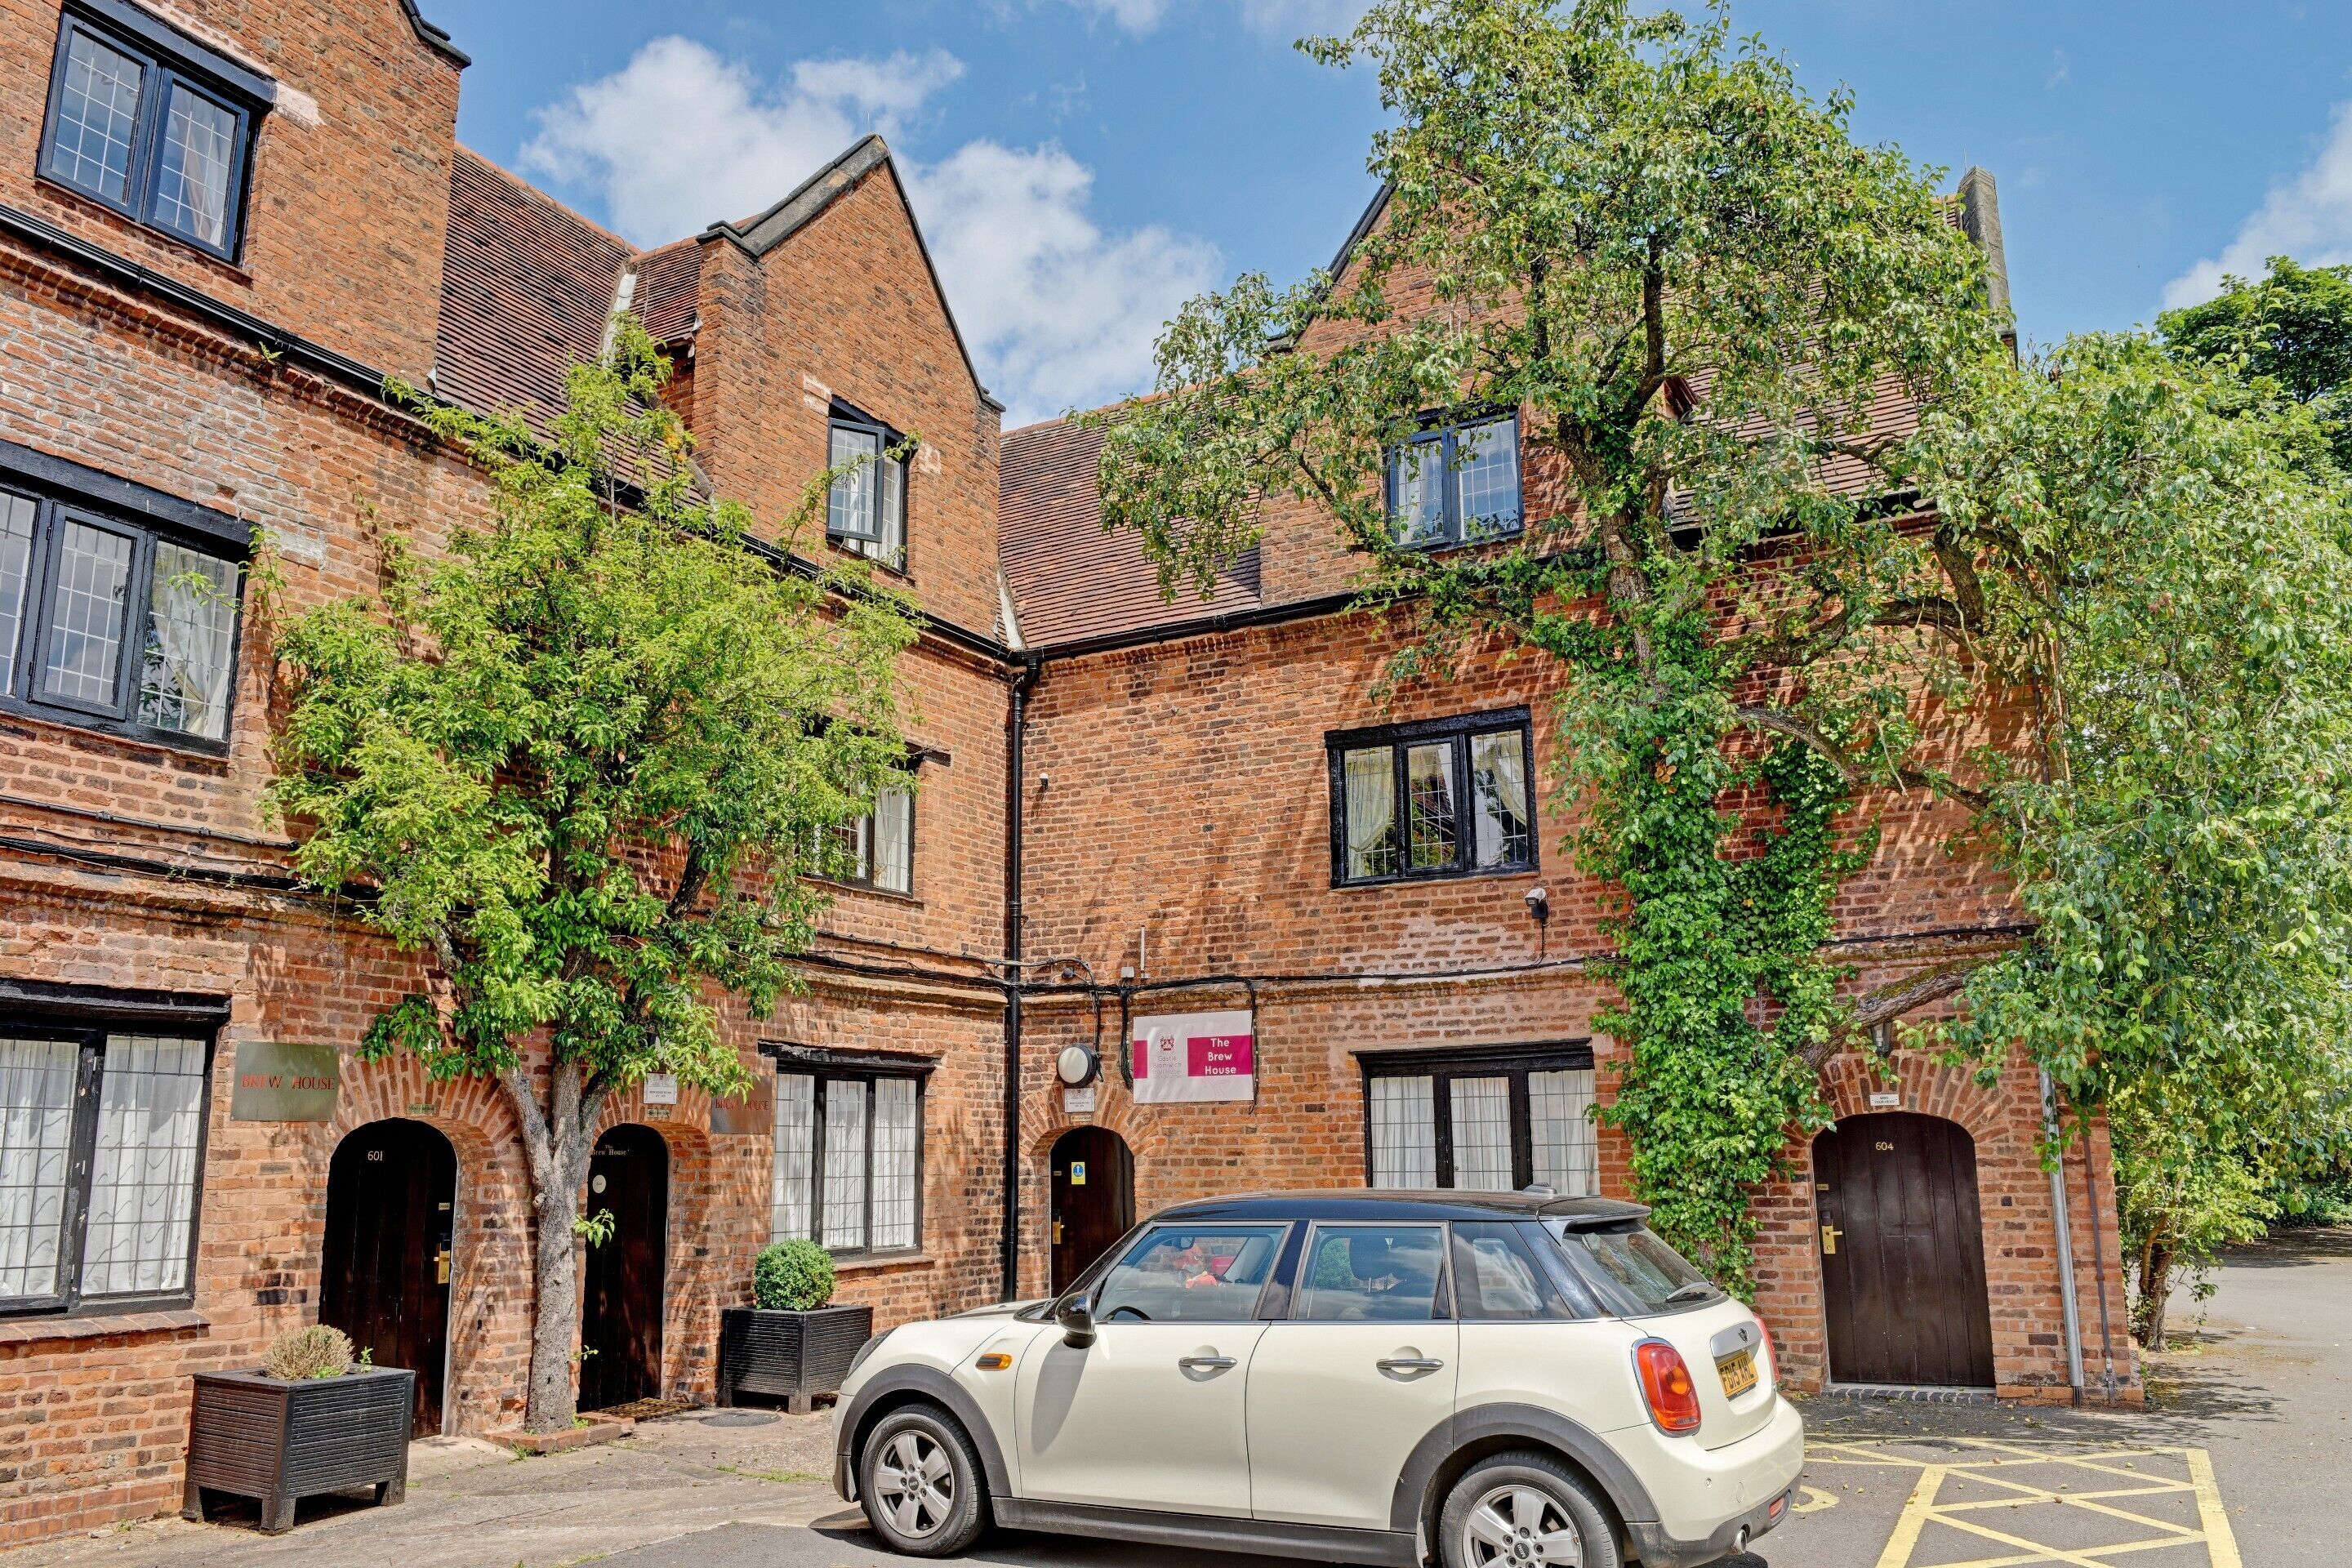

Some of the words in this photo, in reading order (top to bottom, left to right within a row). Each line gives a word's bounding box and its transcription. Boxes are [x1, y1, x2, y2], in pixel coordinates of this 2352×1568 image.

[1209, 1038, 1230, 1048] The
[1208, 1051, 1232, 1062] Brew
[1205, 1065, 1236, 1076] House
[242, 1074, 283, 1089] BREW
[292, 1076, 335, 1090] HOUSE
[715, 1098, 739, 1110] BREW
[744, 1099, 768, 1111] HOUSE
[1875, 1142, 1894, 1151] 604
[368, 1150, 383, 1160] 601
